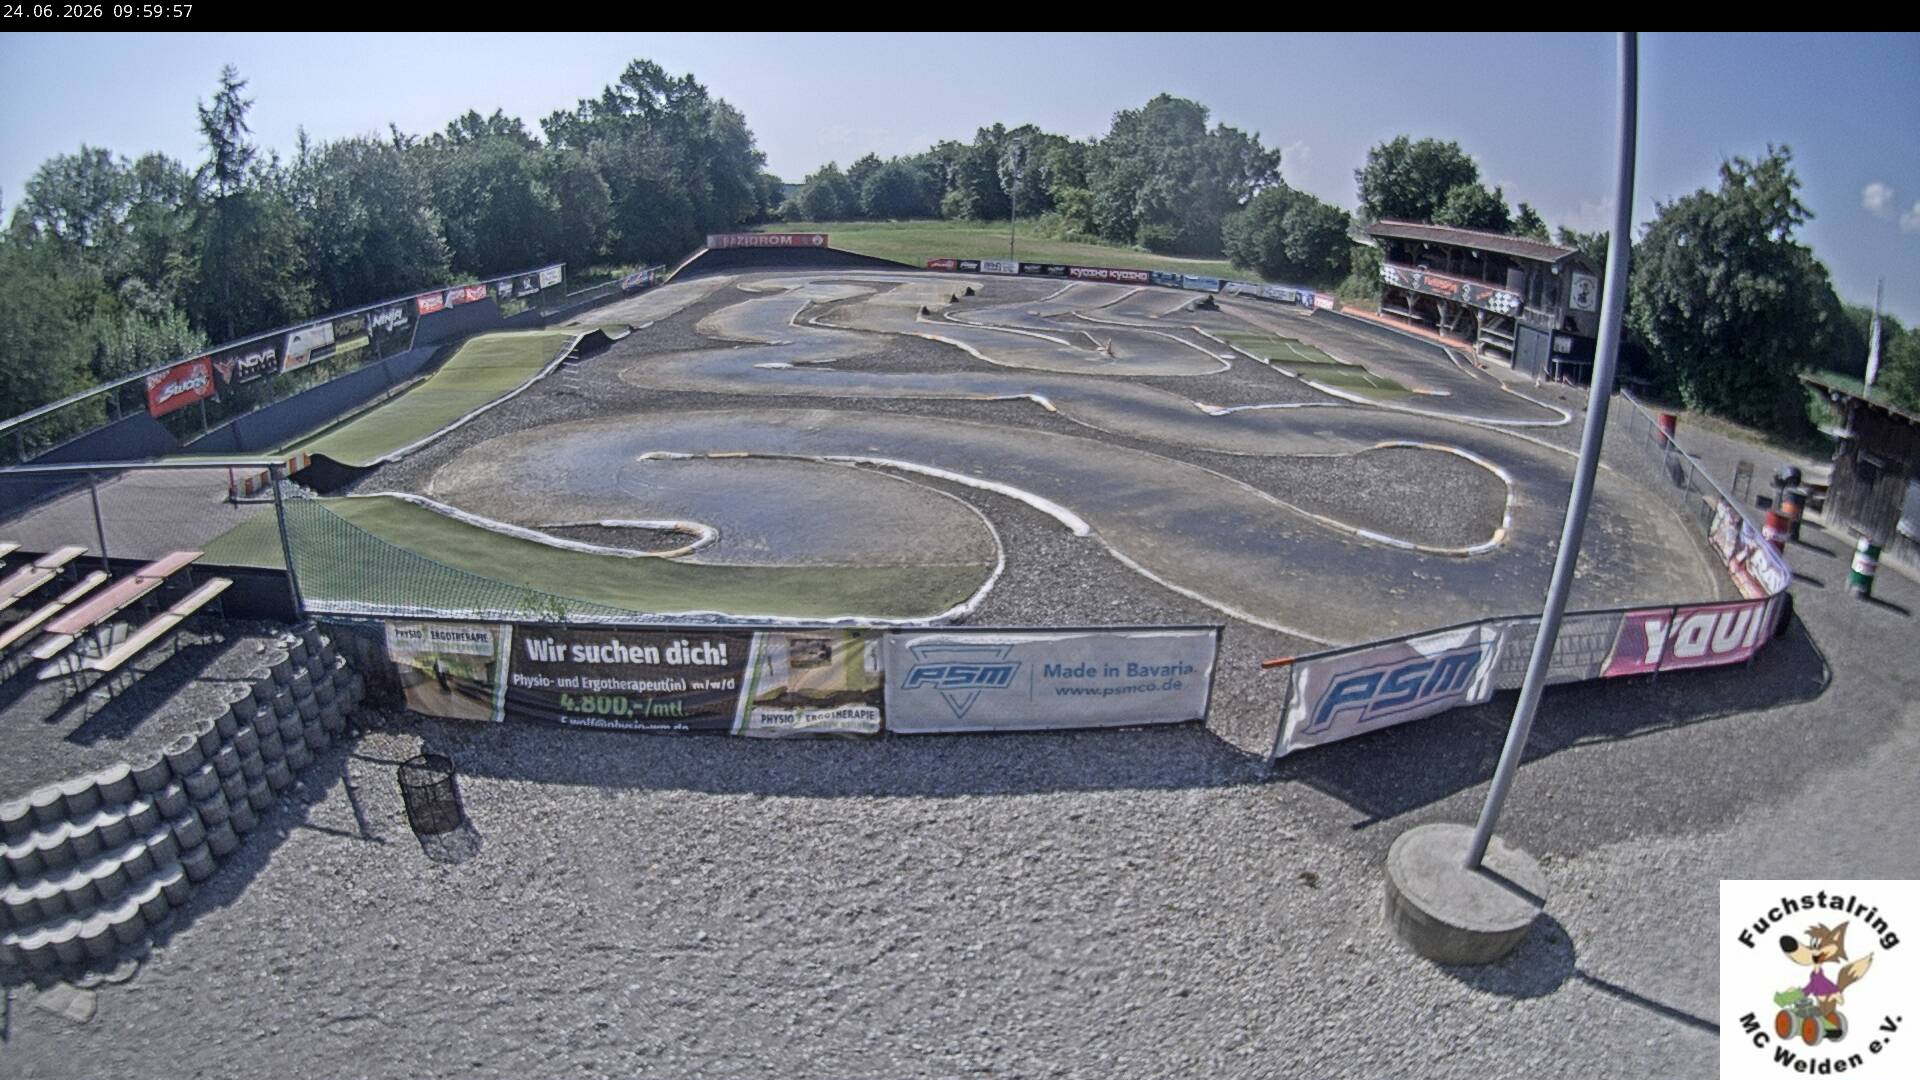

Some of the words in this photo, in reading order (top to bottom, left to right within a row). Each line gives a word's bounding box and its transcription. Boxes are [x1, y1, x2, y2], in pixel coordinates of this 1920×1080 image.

[1070, 268, 1108, 279] KYOSHO
[1109, 270, 1148, 281] KYOSHO
[238, 348, 276, 370] NOVA
[526, 637, 565, 663] Wir
[572, 639, 661, 665] suchen
[665, 639, 729, 666] dich!
[909, 664, 1016, 689] PSM
[1043, 663, 1097, 679] Made
[1103, 662, 1120, 678] in
[513, 673, 555, 688] Physio-
[557, 675, 579, 688] und
[582, 676, 687, 693] Ergotherapeut(in)
[692, 678, 735, 691] m/w/d
[1055, 678, 1183, 698] www.psmco.de
[1314, 650, 1483, 725] PSM
[761, 713, 795, 725] PHYSIO
